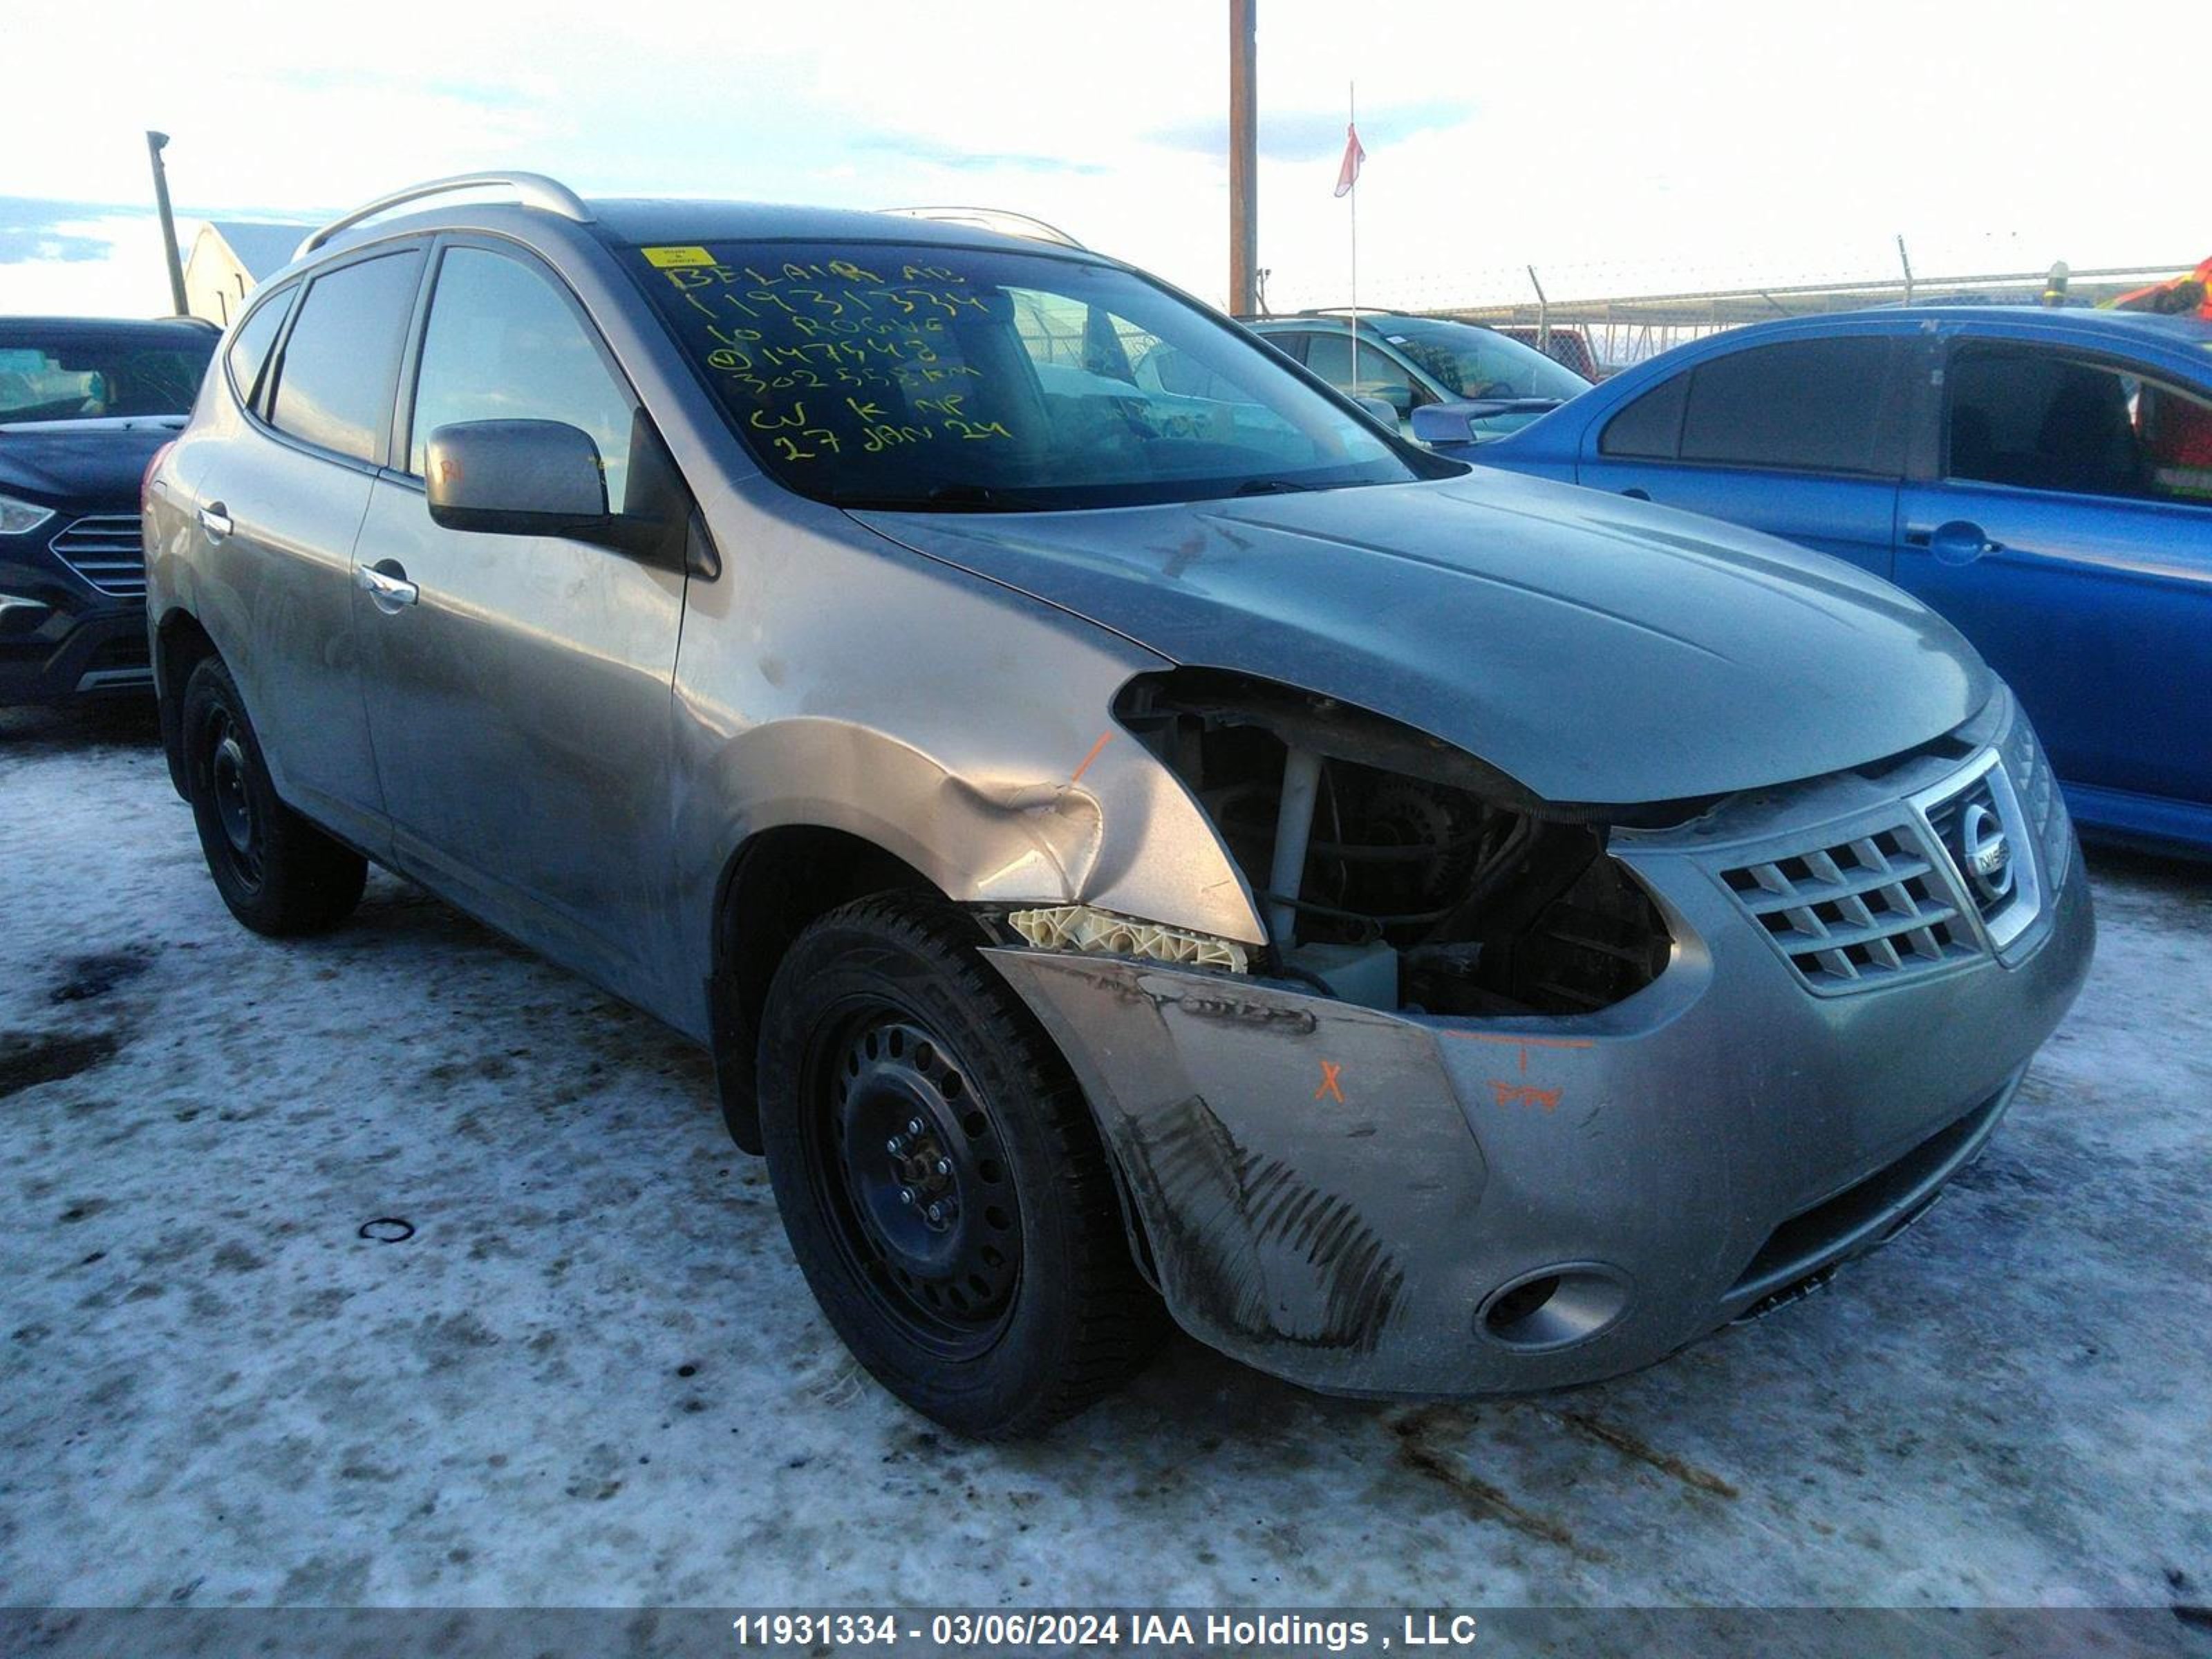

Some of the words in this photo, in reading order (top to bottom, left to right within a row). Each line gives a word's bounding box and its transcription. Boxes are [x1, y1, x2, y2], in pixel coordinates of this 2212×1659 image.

[685, 290, 990, 319] 11931334
[706, 324, 762, 344] 10
[792, 315, 944, 336] ROGUE
[773, 428, 841, 461] 27
[863, 424, 932, 451] JAN
[942, 418, 1012, 439] 24
